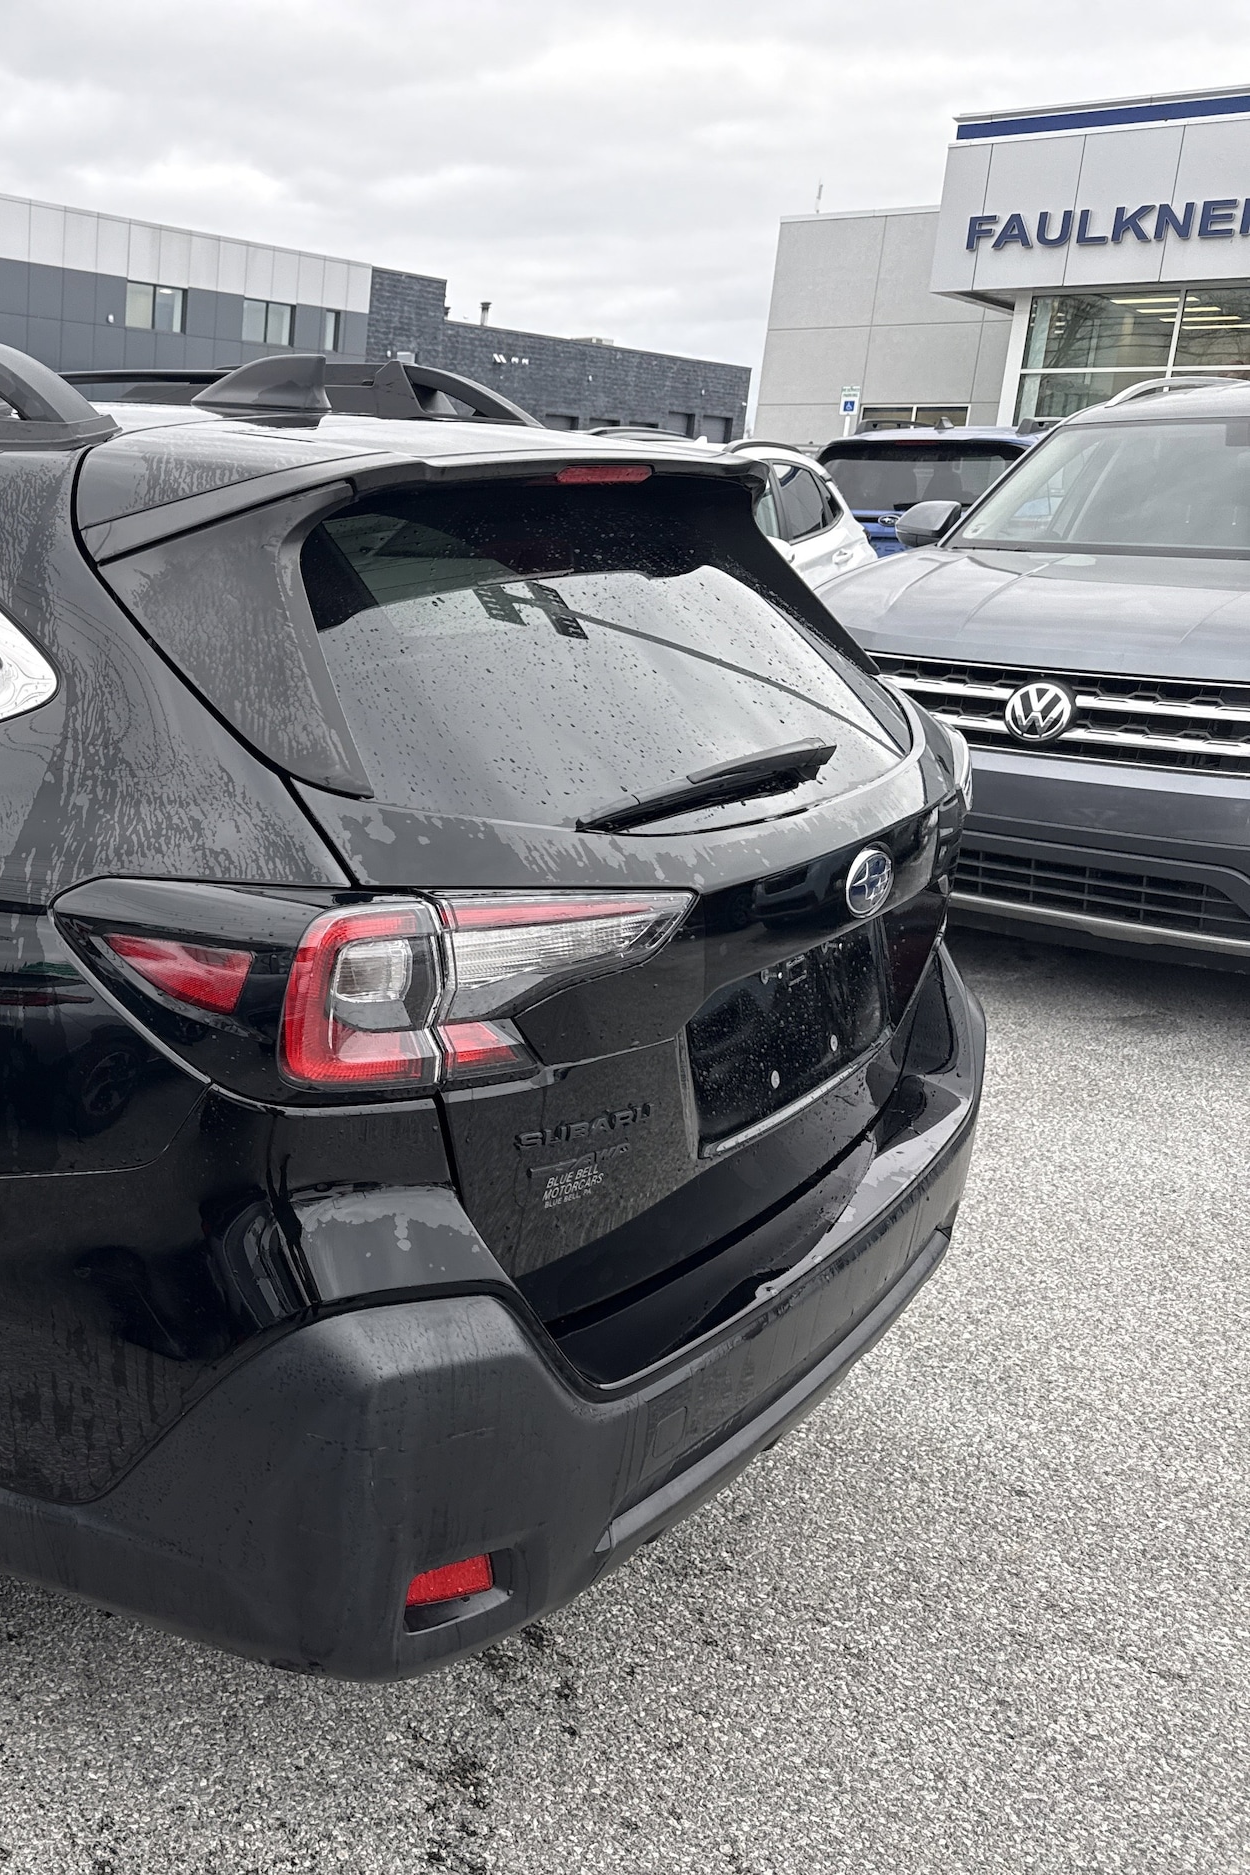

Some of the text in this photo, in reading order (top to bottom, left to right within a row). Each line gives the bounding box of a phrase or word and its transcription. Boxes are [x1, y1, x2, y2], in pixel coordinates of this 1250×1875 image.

[965, 198, 1250, 251] FAULKNE
[515, 1102, 658, 1149] SUBARU
[542, 1173, 604, 1201] MOTORCARS
[546, 1171, 574, 1188] BLUE
[575, 1164, 598, 1180] BELL
[545, 1197, 562, 1208] BLUE
